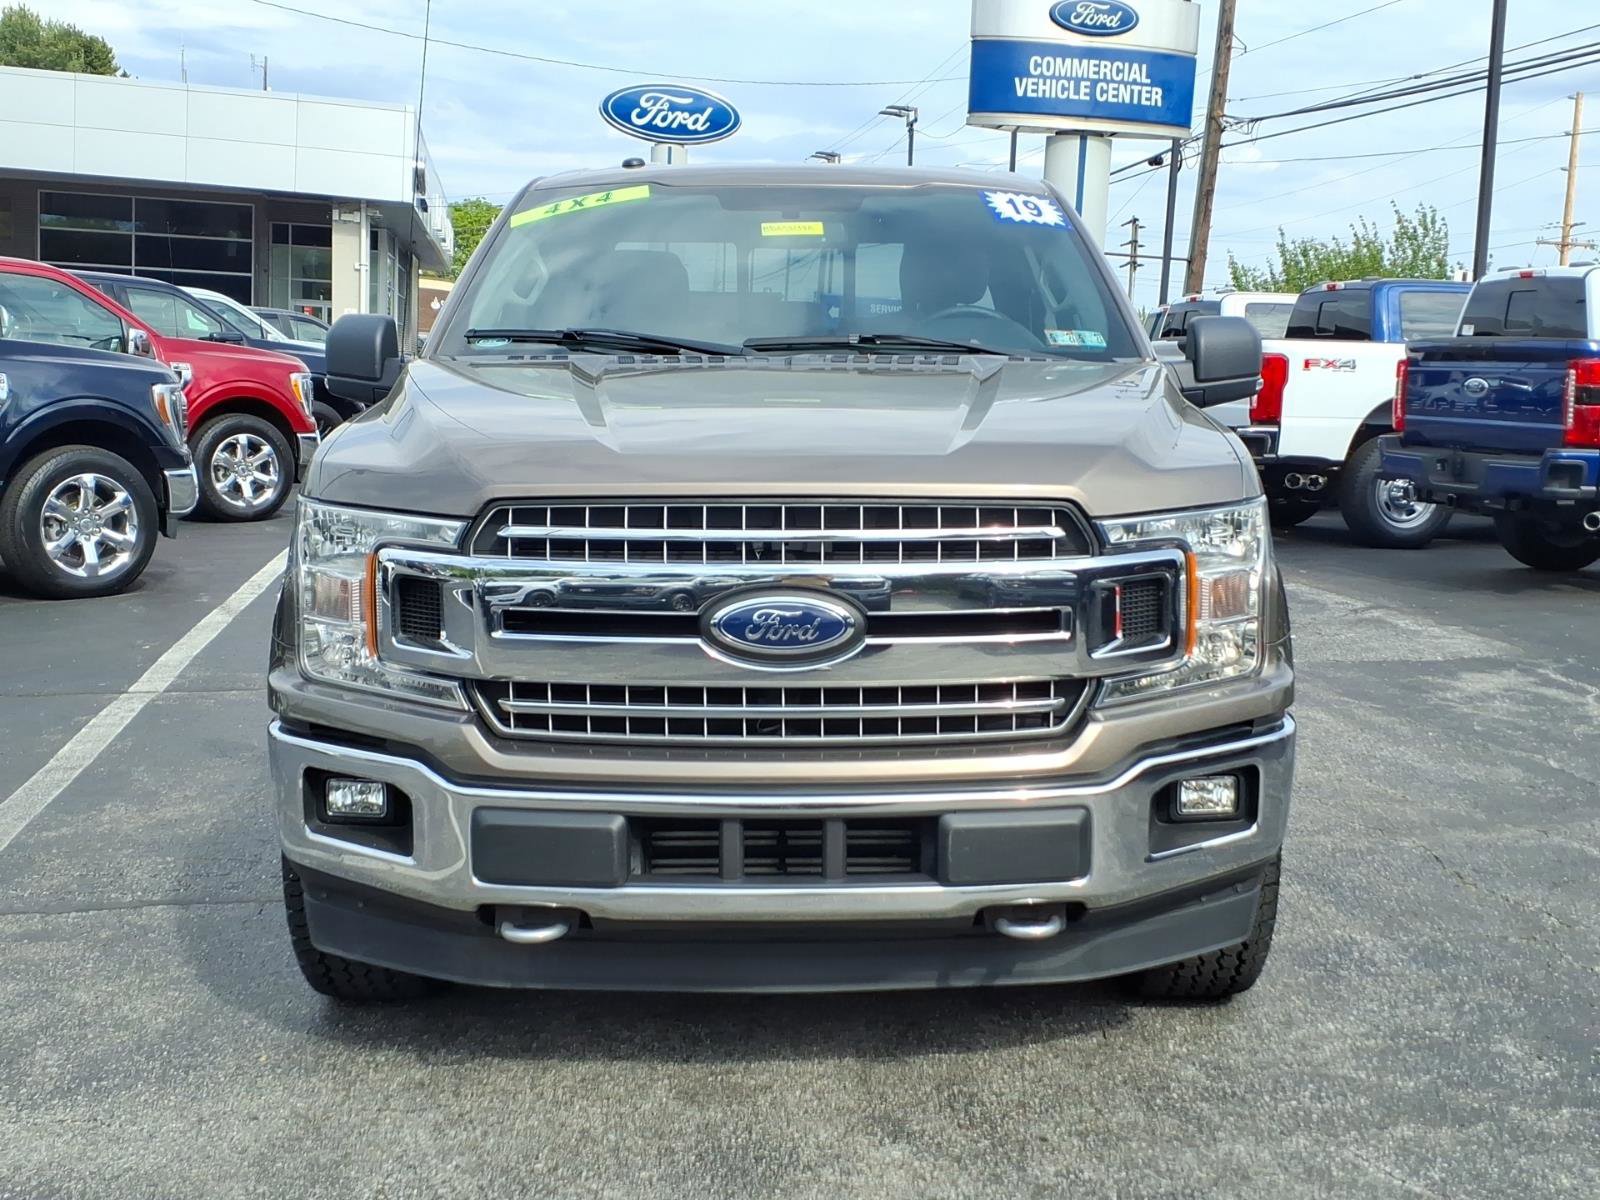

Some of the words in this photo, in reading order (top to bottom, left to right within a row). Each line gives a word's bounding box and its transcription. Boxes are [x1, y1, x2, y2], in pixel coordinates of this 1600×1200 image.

[1070, 2, 1122, 28] Ford
[1029, 55, 1151, 84] COMMERCIAL
[1014, 77, 1090, 101] VEHICLE
[1095, 82, 1163, 107] CENTER
[630, 92, 714, 131] Ford
[1006, 197, 1043, 217] 19
[1302, 358, 1357, 370] FX4
[744, 609, 821, 641] Ford
